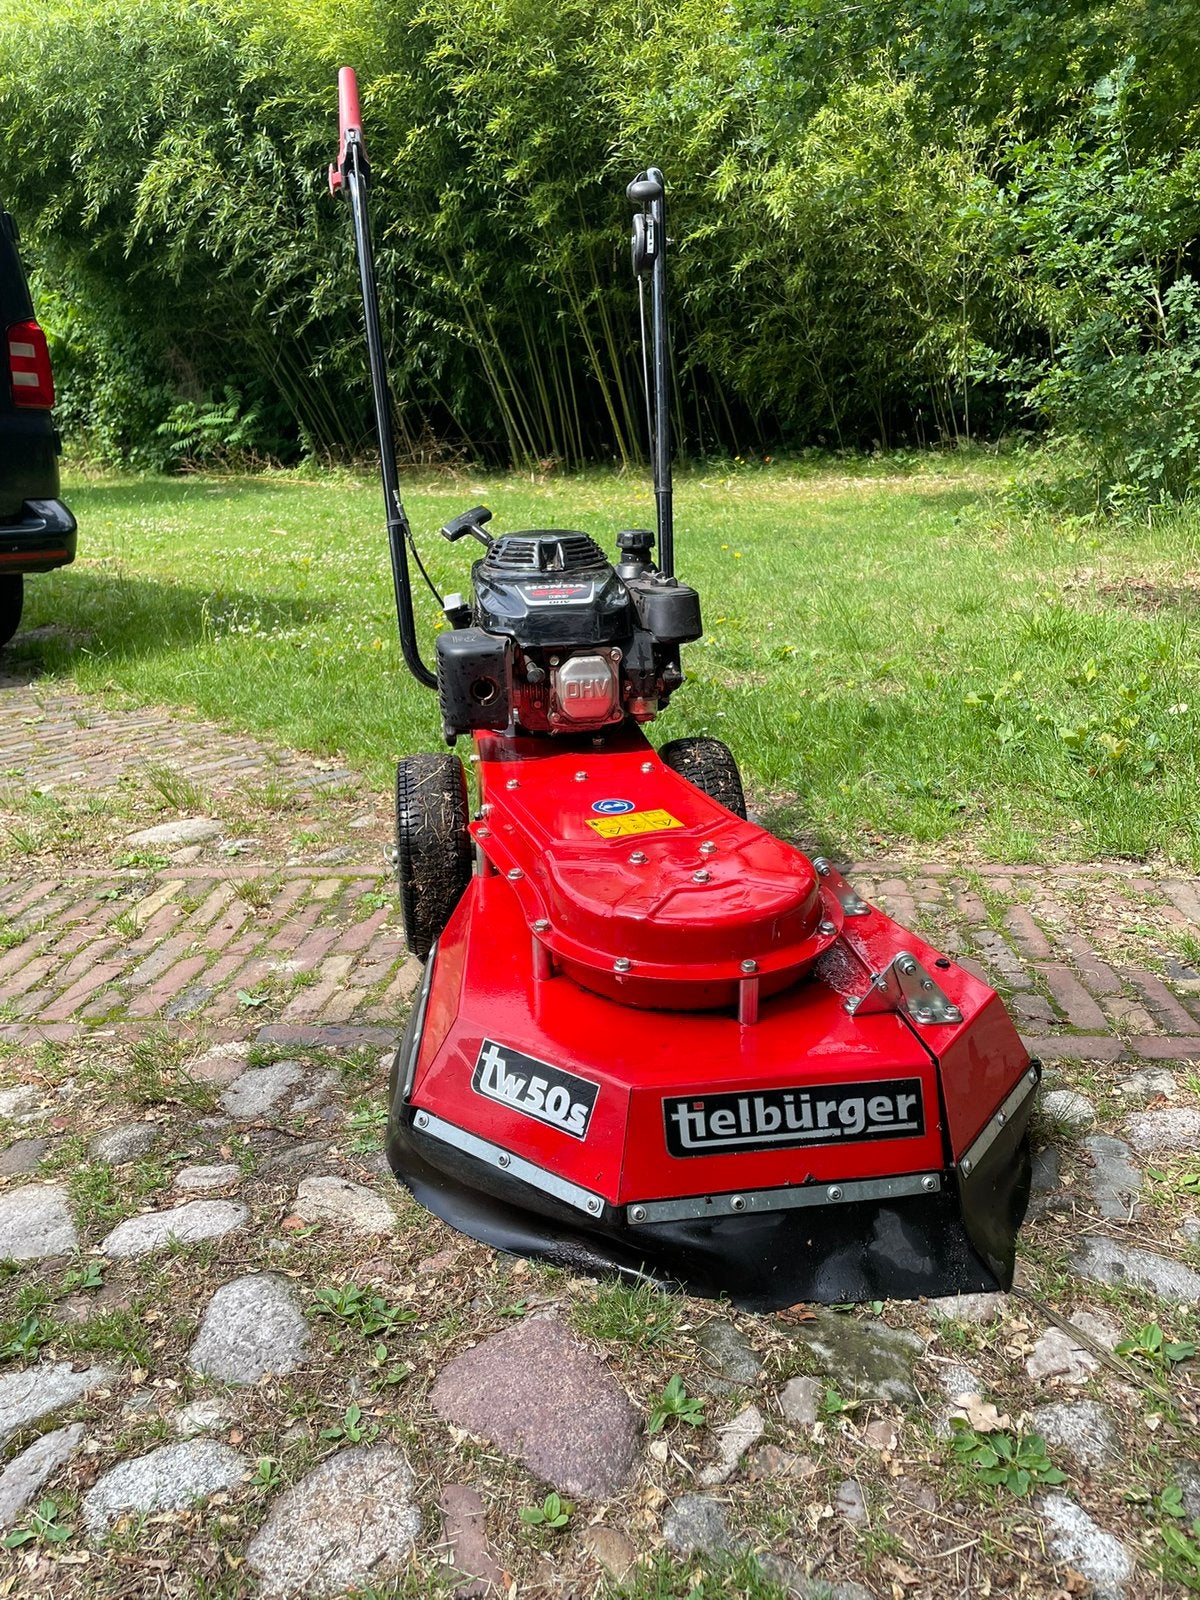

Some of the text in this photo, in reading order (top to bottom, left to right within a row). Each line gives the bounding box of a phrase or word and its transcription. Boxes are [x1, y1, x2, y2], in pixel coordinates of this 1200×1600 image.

[565, 679, 608, 699] OHV
[480, 1045, 589, 1136] tw50s
[671, 1093, 917, 1148] tielbürger
